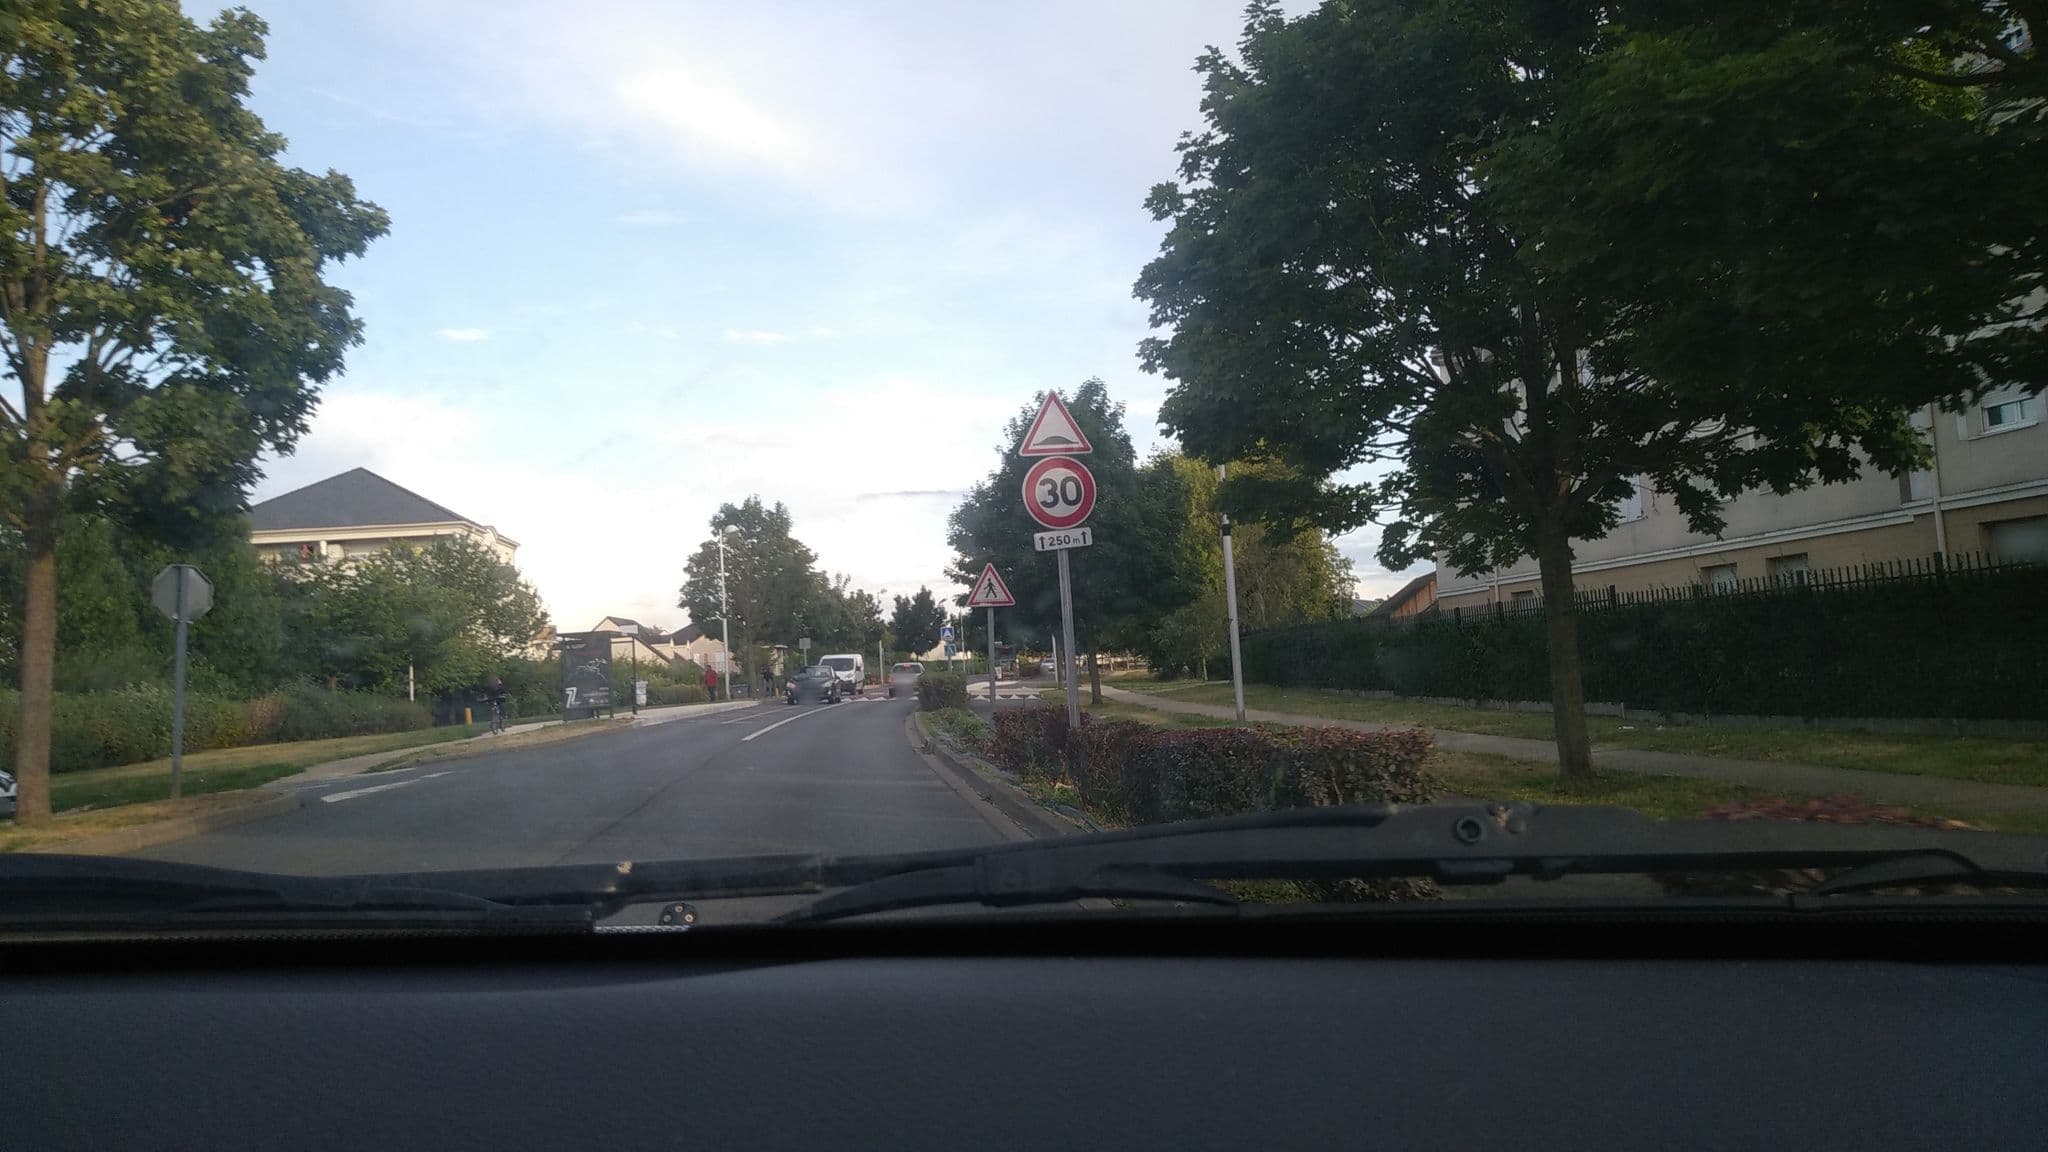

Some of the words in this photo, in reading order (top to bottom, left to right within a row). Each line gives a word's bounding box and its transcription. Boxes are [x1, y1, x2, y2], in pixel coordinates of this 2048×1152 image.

[1038, 476, 1083, 509] 30
[1048, 535, 1071, 547] 250
[1072, 537, 1081, 545] m
